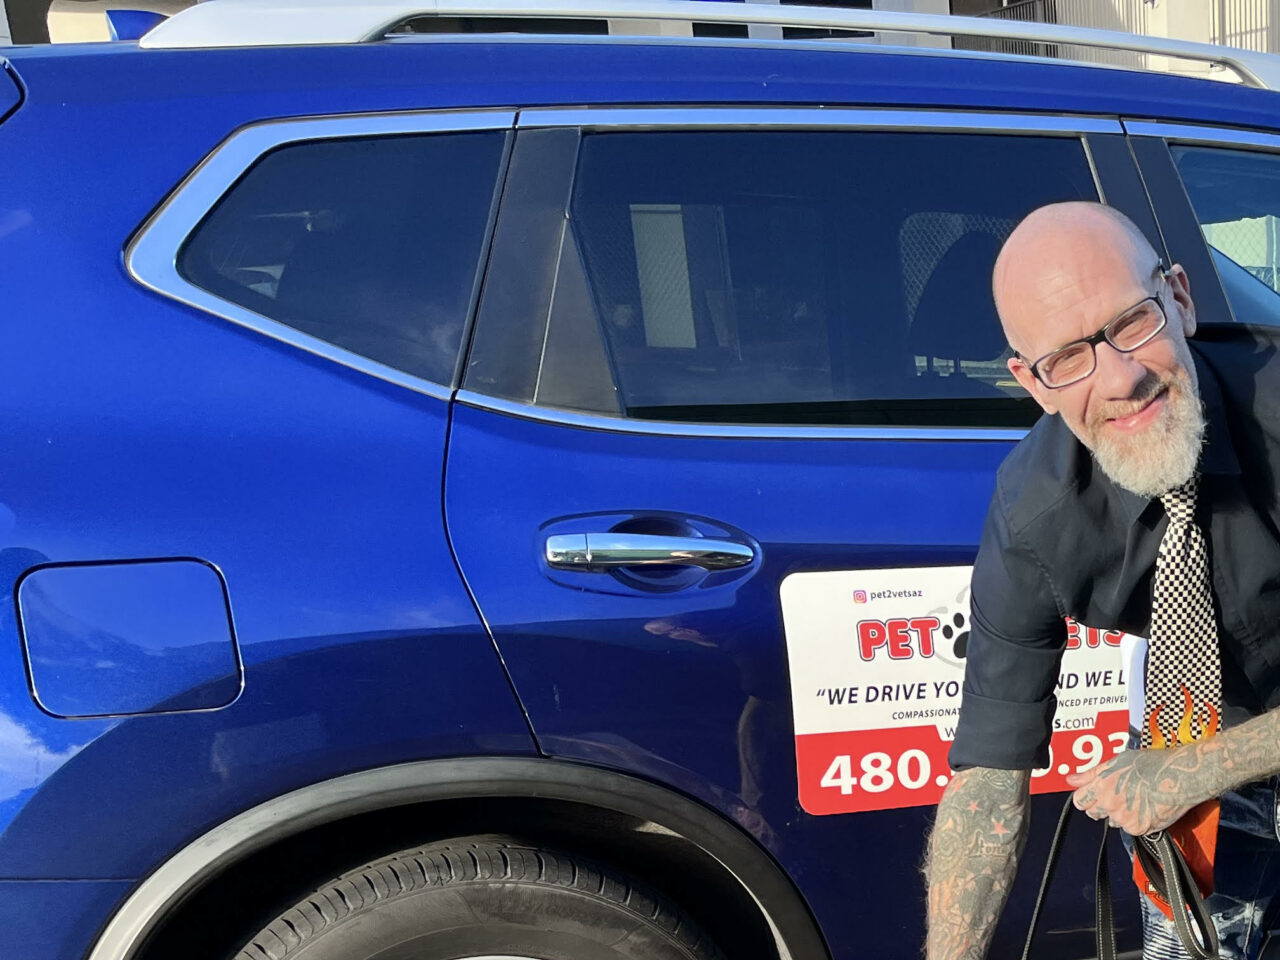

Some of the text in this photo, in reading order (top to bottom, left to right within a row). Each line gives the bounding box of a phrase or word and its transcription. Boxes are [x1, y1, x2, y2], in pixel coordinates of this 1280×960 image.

[870, 589, 923, 601] pet2vetsaz
[857, 617, 941, 662] PET
[865, 682, 927, 703] DRIVE
[1085, 671, 1113, 687] WE
[1083, 697, 1099, 706] PET
